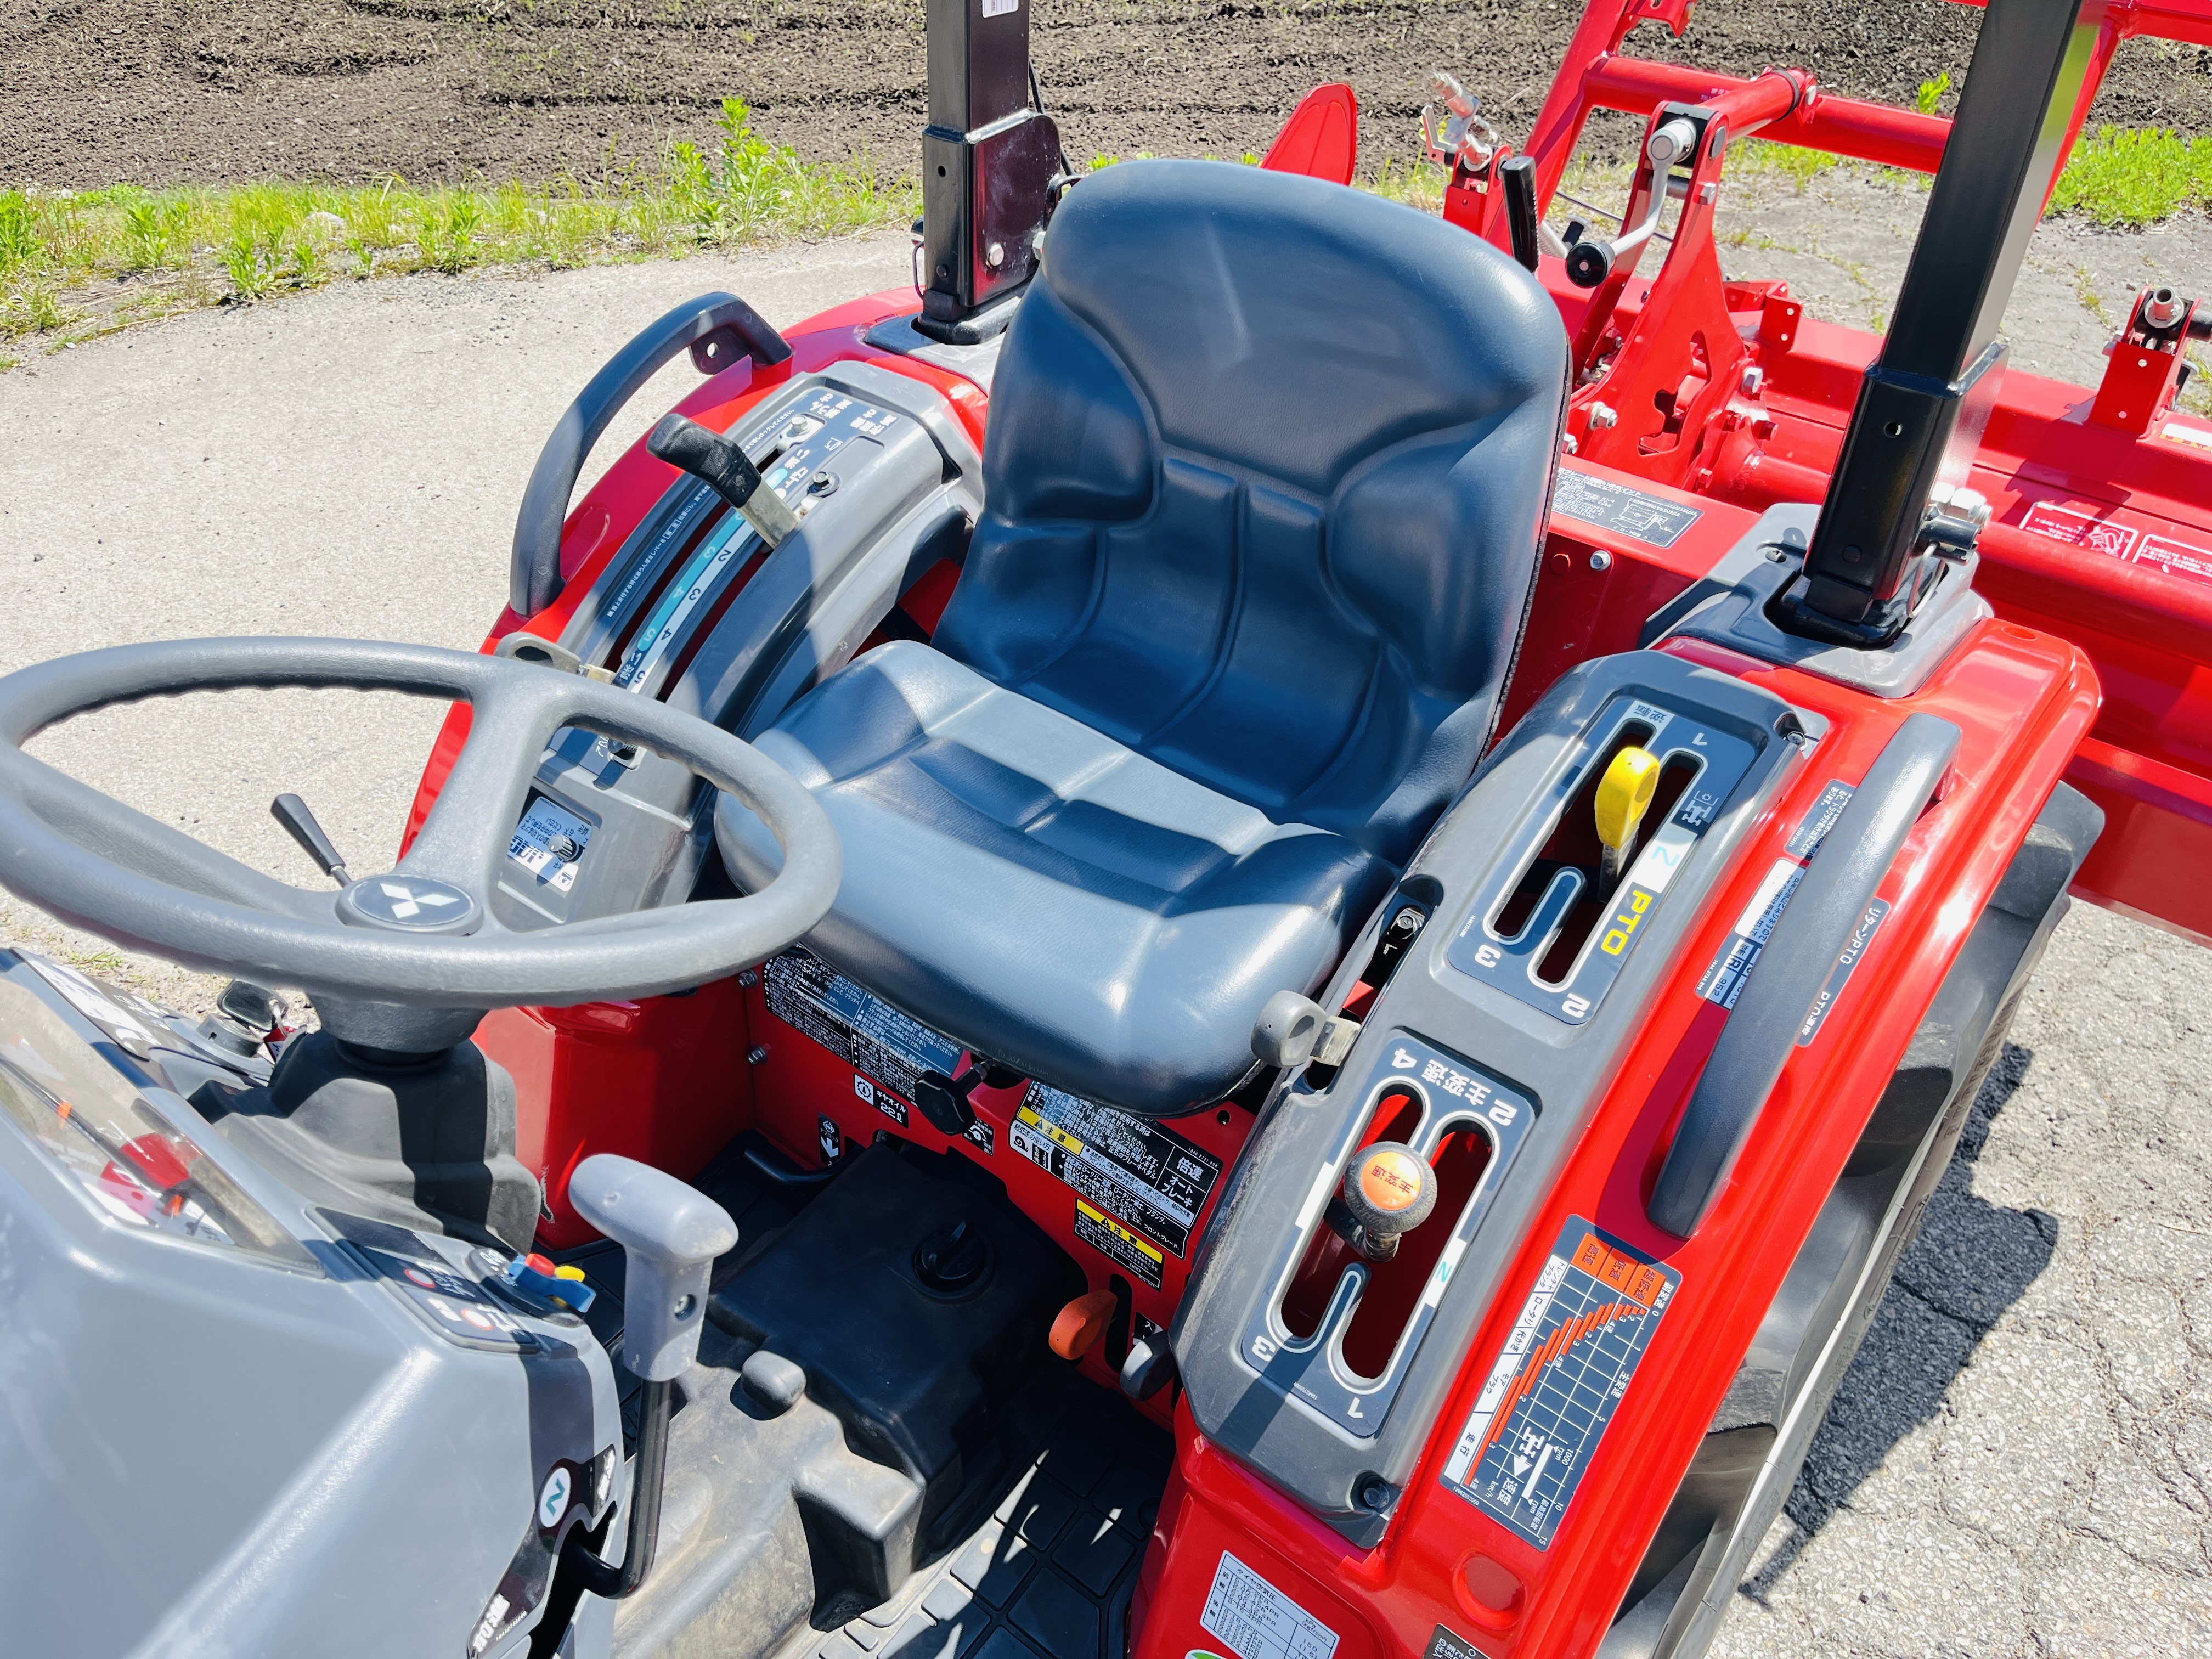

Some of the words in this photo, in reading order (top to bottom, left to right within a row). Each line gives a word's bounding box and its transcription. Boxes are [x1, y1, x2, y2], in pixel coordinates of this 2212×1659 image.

[703, 546, 716, 559] 3
[718, 549, 731, 562] 2
[673, 586, 685, 599] 4
[689, 588, 701, 601] 3
[644, 628, 657, 641] 5
[661, 628, 672, 641] 4
[1633, 697, 1668, 726] 逆転
[1691, 729, 1712, 750] 1
[1650, 841, 1681, 870] N
[1598, 886, 1653, 959] PTO
[1838, 905, 1881, 966] リターンPTO
[1472, 941, 1503, 970] 3
[1727, 956, 1742, 970] R
[1710, 976, 1728, 997] 952
[1559, 990, 1592, 1022] 2
[1391, 1048, 1417, 1068] 4
[1421, 1060, 1491, 1106] 主変速
[874, 1090, 908, 1113] ギヤオイル
[1489, 1101, 1516, 1125] 2
[1173, 1155, 1205, 1183] 倍速
[1369, 1162, 1415, 1197] 主変速
[1159, 1181, 1195, 1209] ブレーキ
[1167, 1173, 1197, 1197] オート
[1580, 1242, 1600, 1266] 高速
[1434, 1260, 1454, 1283] N
[1543, 1259, 1566, 1291] トレンチャ
[1607, 1257, 1627, 1281] 低速
[1632, 1268, 1657, 1302] 超低速
[1652, 1281, 1674, 1310] 副変速
[1522, 1295, 1544, 1325] ロータリ
[1626, 1313, 1635, 1322] 2
[1509, 1328, 1528, 1353] 代かき
[1571, 1339, 1580, 1347] 3
[1583, 1331, 1592, 1339] 2
[1249, 1334, 1279, 1363] 3
[1497, 1370, 1510, 1387] モア
[1610, 1369, 1629, 1397] 主変速
[1345, 1397, 1370, 1423] 1
[1457, 1431, 1477, 1457] 走行
[1553, 1446, 1565, 1462] rpm
[1559, 1447, 1575, 1466] 1000
[545, 1478, 566, 1517] N
[1483, 1479, 1498, 1499] km/h
[1494, 1476, 1520, 1507] 速度
[1527, 1499, 1540, 1515] rpm
[1527, 1498, 1551, 1531] 最高回転数
[1236, 1567, 1277, 1603] タイヤ空気圧
